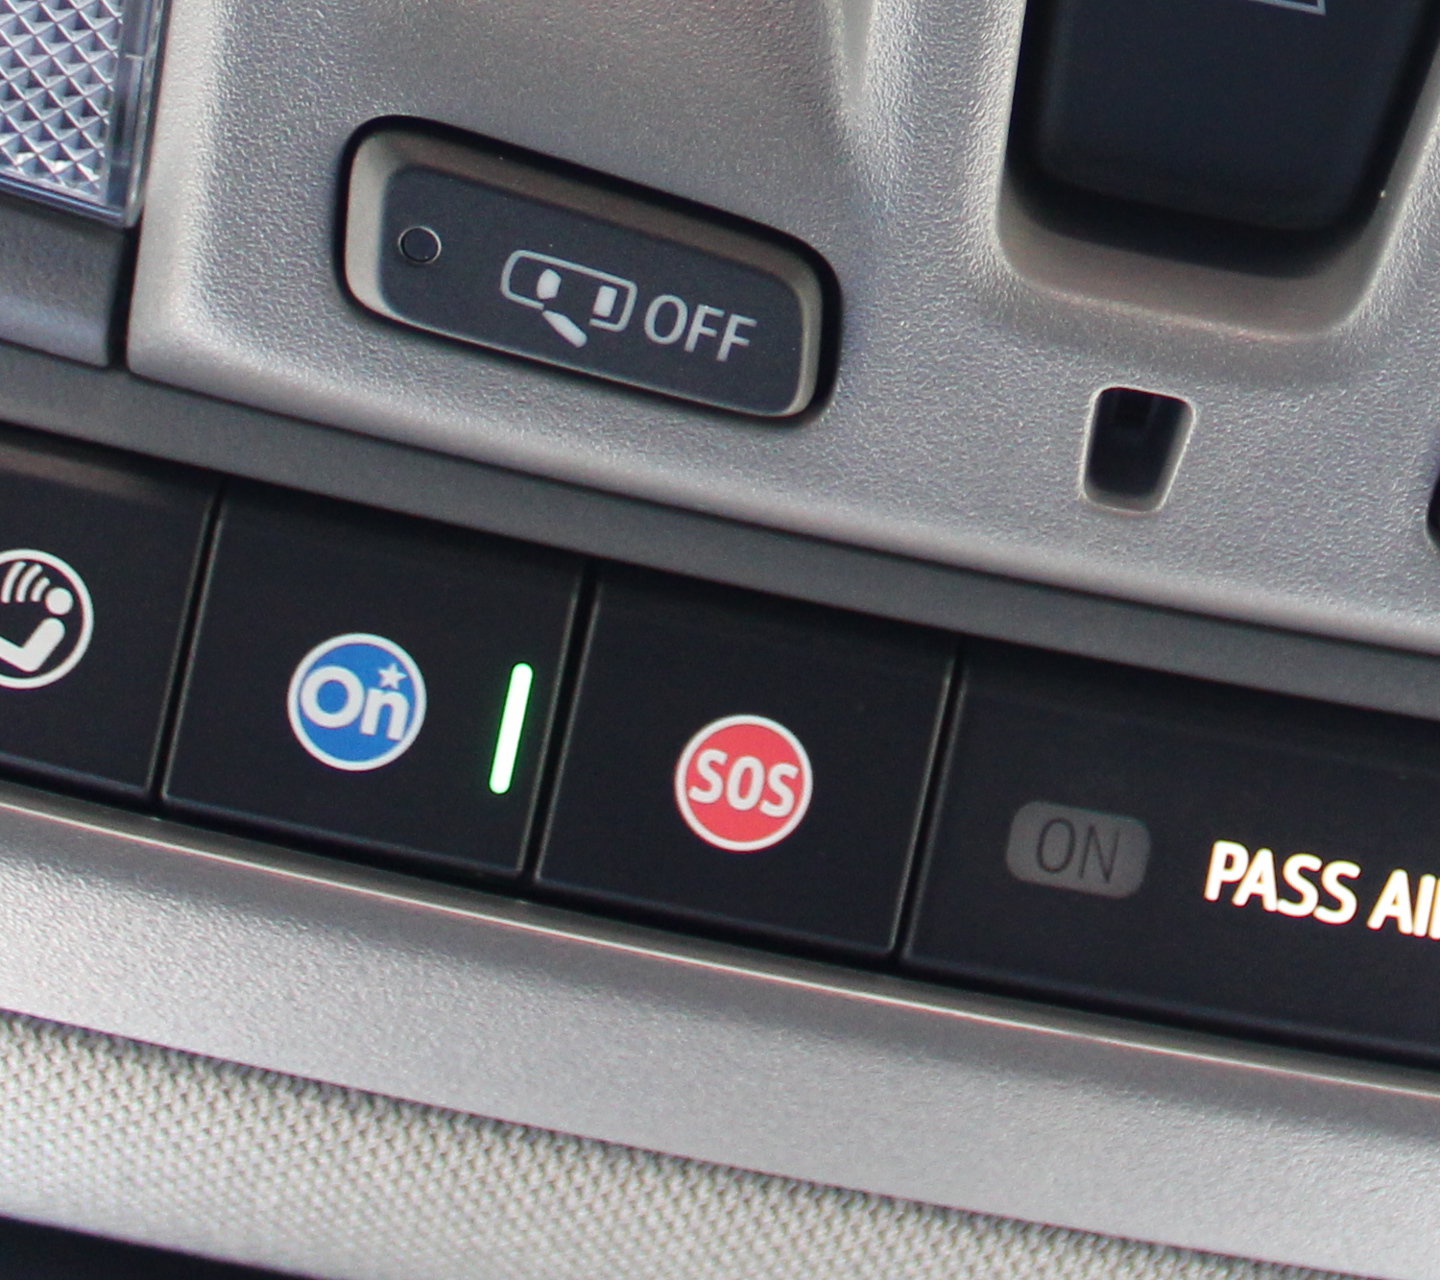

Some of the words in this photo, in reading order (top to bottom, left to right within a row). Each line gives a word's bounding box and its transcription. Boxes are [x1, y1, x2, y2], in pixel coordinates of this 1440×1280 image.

[643, 294, 758, 362] OFF
[299, 663, 412, 741] On
[688, 747, 799, 819] SOS
[1035, 817, 1122, 884] ON
[1202, 840, 1360, 926] PASS
